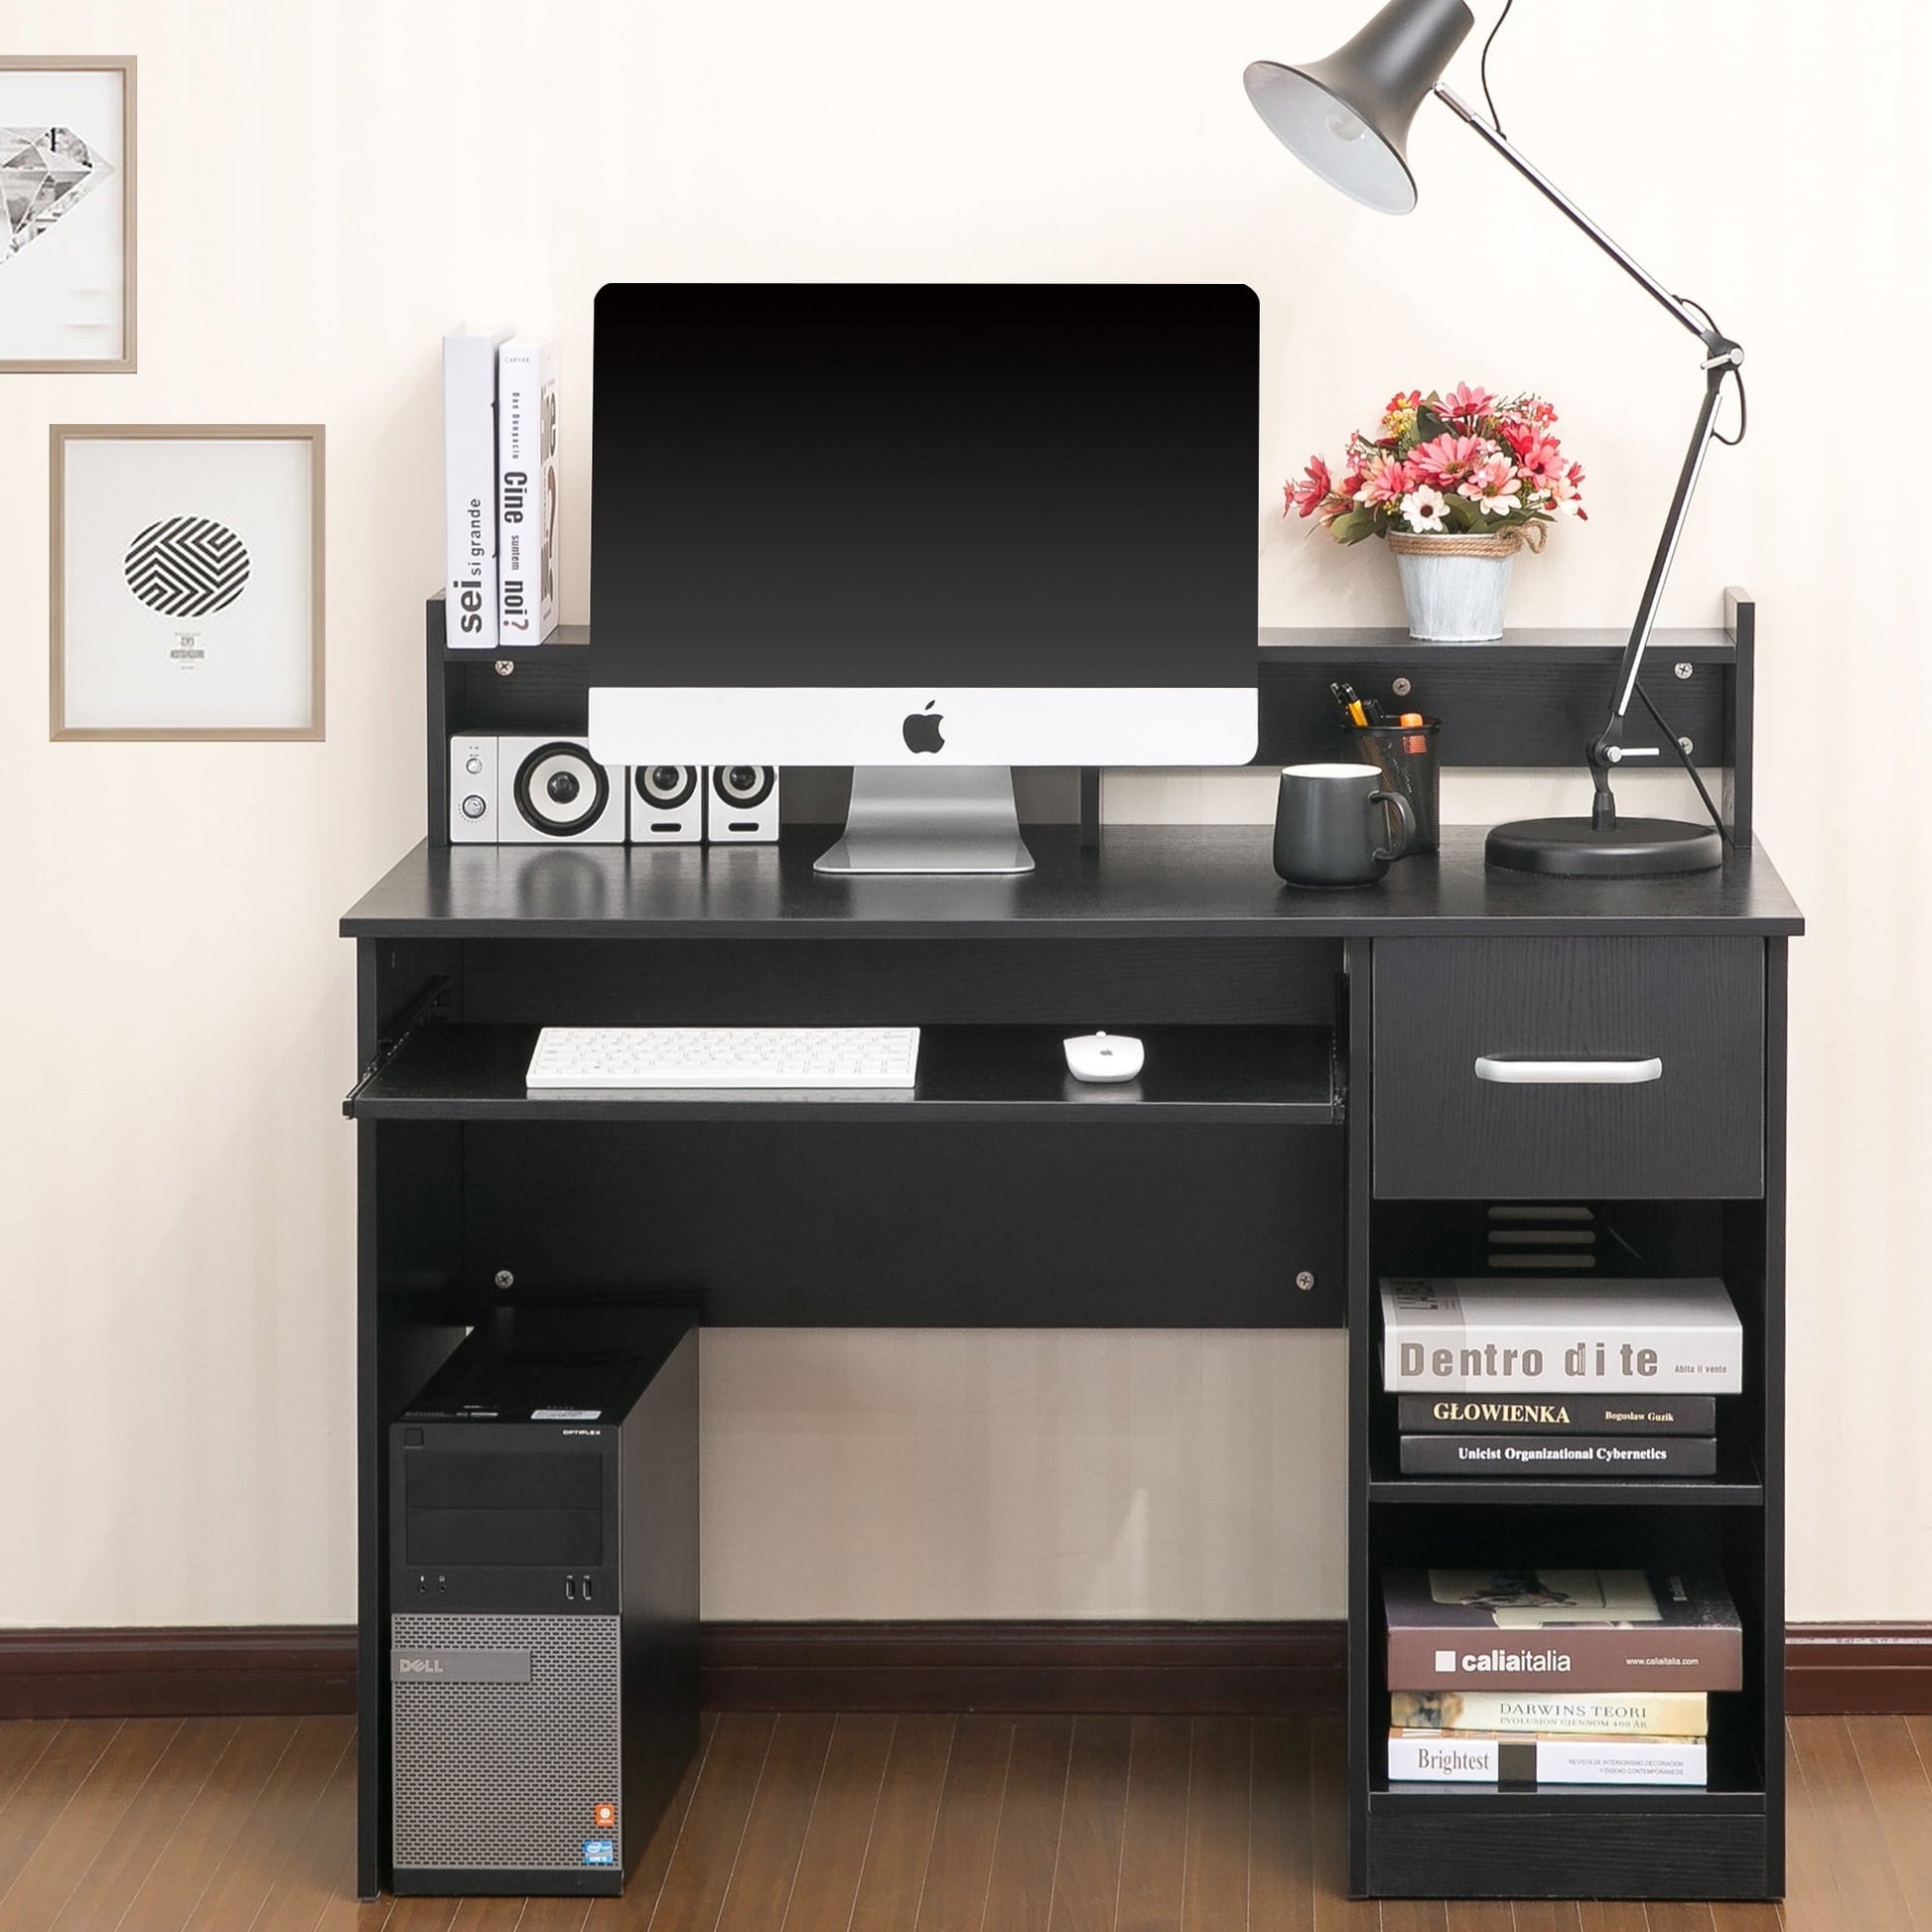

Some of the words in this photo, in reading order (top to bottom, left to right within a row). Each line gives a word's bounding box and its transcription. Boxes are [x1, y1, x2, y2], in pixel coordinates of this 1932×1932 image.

[503, 472, 528, 523] Cine
[453, 581, 483, 633] sei
[468, 498, 484, 557] grande
[511, 535, 520, 571] suntem
[503, 581, 529, 630] noi?
[1400, 1342, 1543, 1376] Dentro
[1565, 1342, 1604, 1377] di
[1619, 1343, 1658, 1377] te
[1705, 1365, 1727, 1374] vento
[1433, 1402, 1571, 1424] GŁOWIENKA
[1647, 1412, 1674, 1422] Guzik
[1457, 1448, 1502, 1459] Unicist
[1504, 1448, 1593, 1462] Organizational
[1595, 1448, 1668, 1462] Cybernetics
[399, 1659, 444, 1673] DELL
[1461, 1649, 1572, 1672] caliaitalia
[1625, 1657, 1699, 1666] www.caliaitalia.com
[1499, 1703, 1587, 1717] DARWINS
[1590, 1706, 1647, 1719] TEORI
[1418, 1748, 1489, 1774] Brightest
